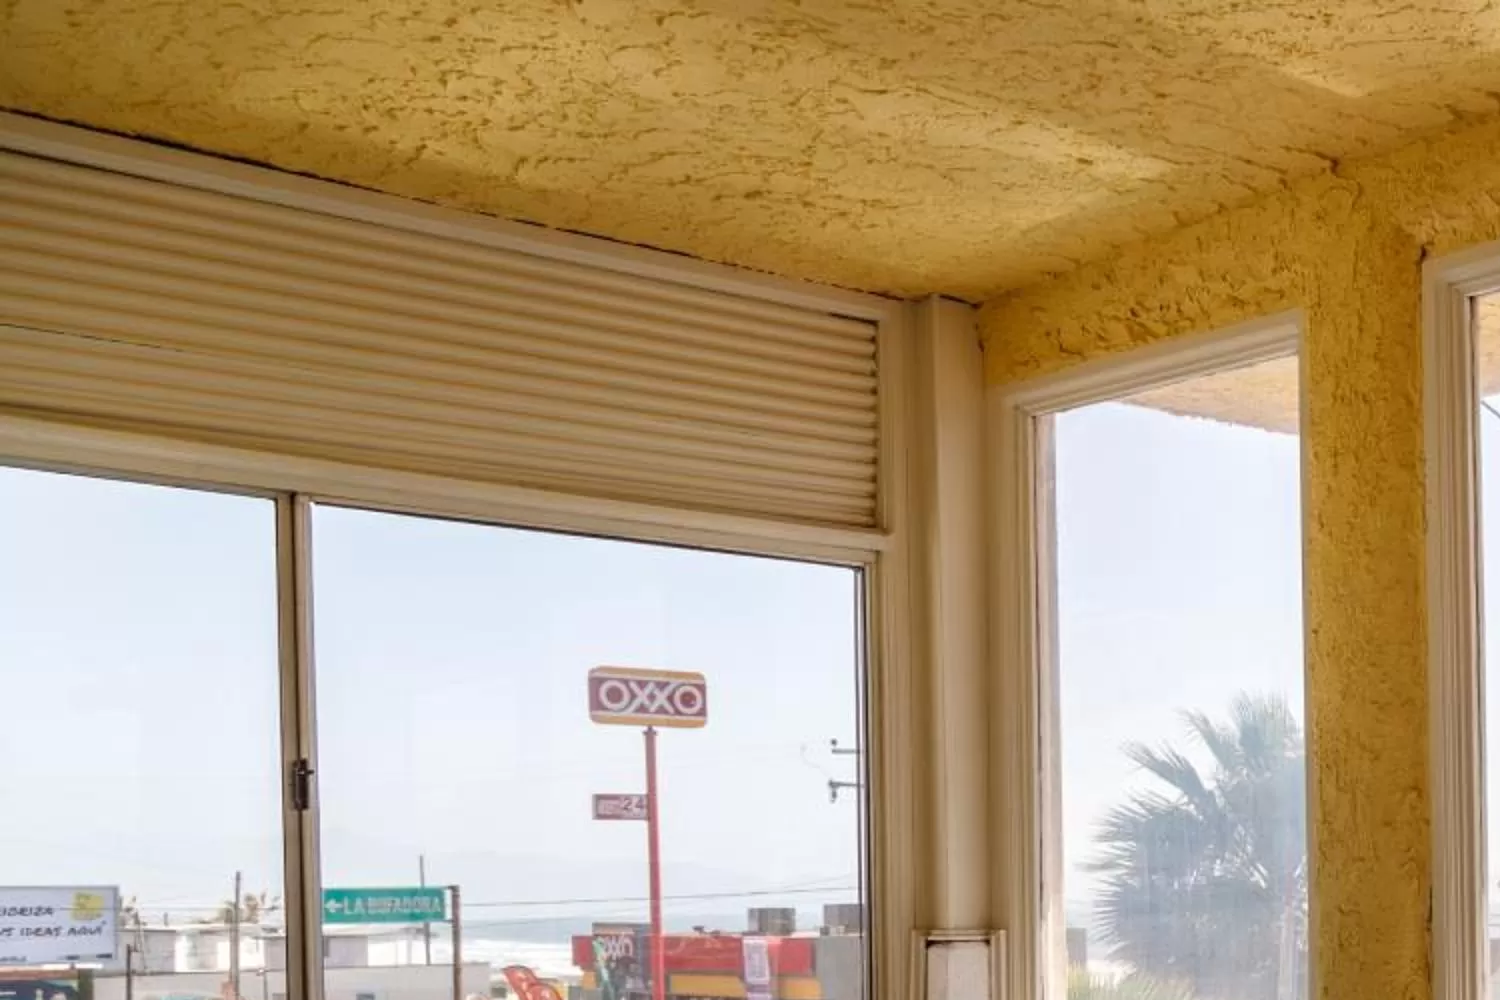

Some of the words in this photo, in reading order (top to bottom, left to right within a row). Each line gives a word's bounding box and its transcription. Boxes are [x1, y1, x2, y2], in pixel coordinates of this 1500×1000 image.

[599, 679, 703, 716] OXXO
[343, 895, 365, 914] LA
[20, 926, 61, 937] IDEAS
